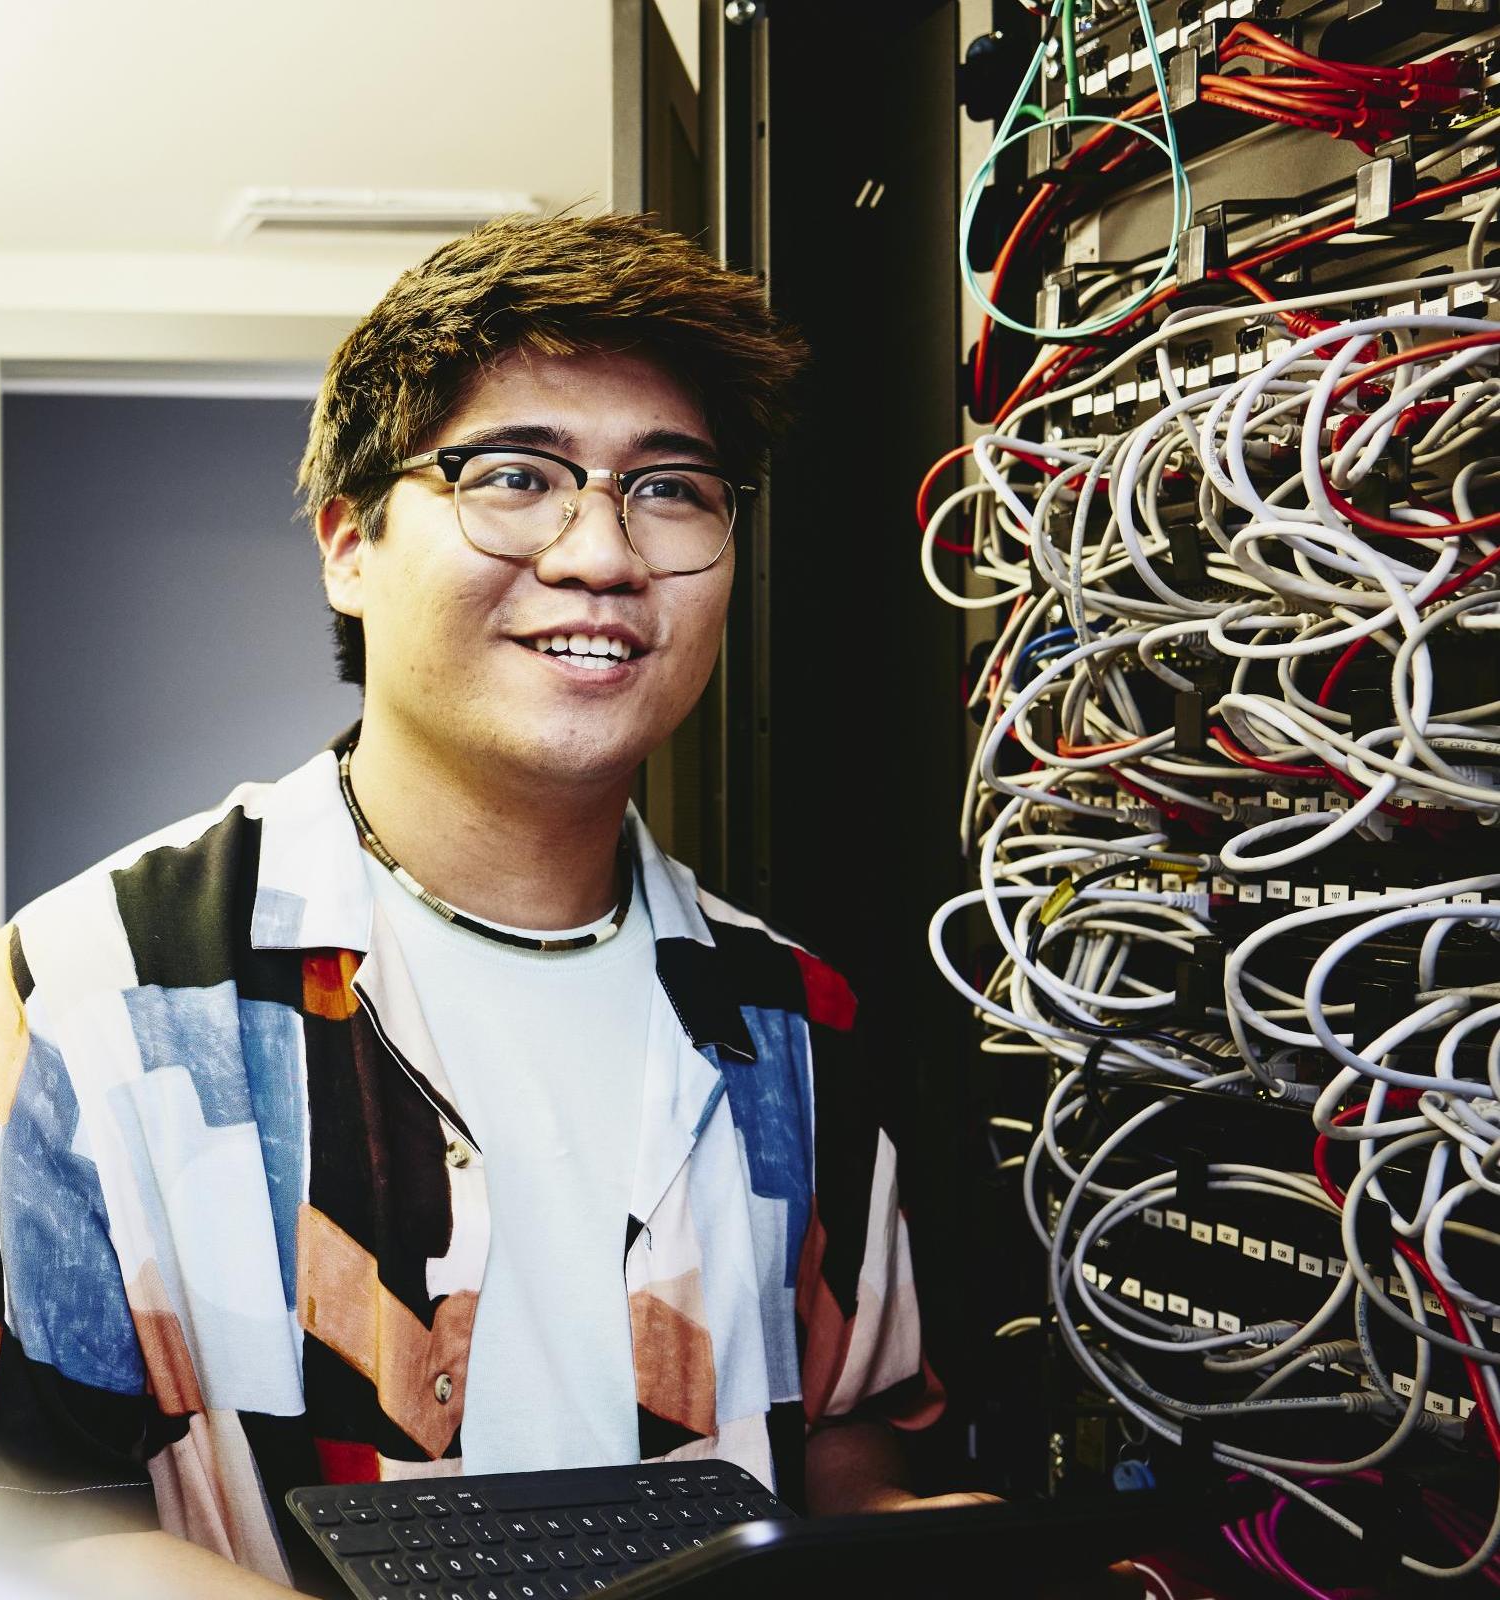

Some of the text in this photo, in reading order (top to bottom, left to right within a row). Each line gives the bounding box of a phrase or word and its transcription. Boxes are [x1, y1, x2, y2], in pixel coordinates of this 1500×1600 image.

[1331, 892, 1341, 900] 107
[1277, 1250, 1287, 1258] 129
[1306, 1262, 1315, 1271] 130
[1400, 1382, 1411, 1392] 157
[1432, 1400, 1444, 1411] 158
[680, 1510, 692, 1518] X
[714, 1507, 724, 1516] Y
[616, 1515, 626, 1524] V
[648, 1512, 658, 1520] C
[548, 1521, 560, 1529] N
[582, 1518, 593, 1526] B
[512, 1524, 526, 1532] M
[626, 1544, 637, 1553] G
[662, 1542, 671, 1550] F
[558, 1551, 566, 1559] J
[592, 1548, 604, 1556] H
[487, 1557, 498, 1566] L
[522, 1554, 534, 1562] K
[522, 1586, 534, 1596] O
